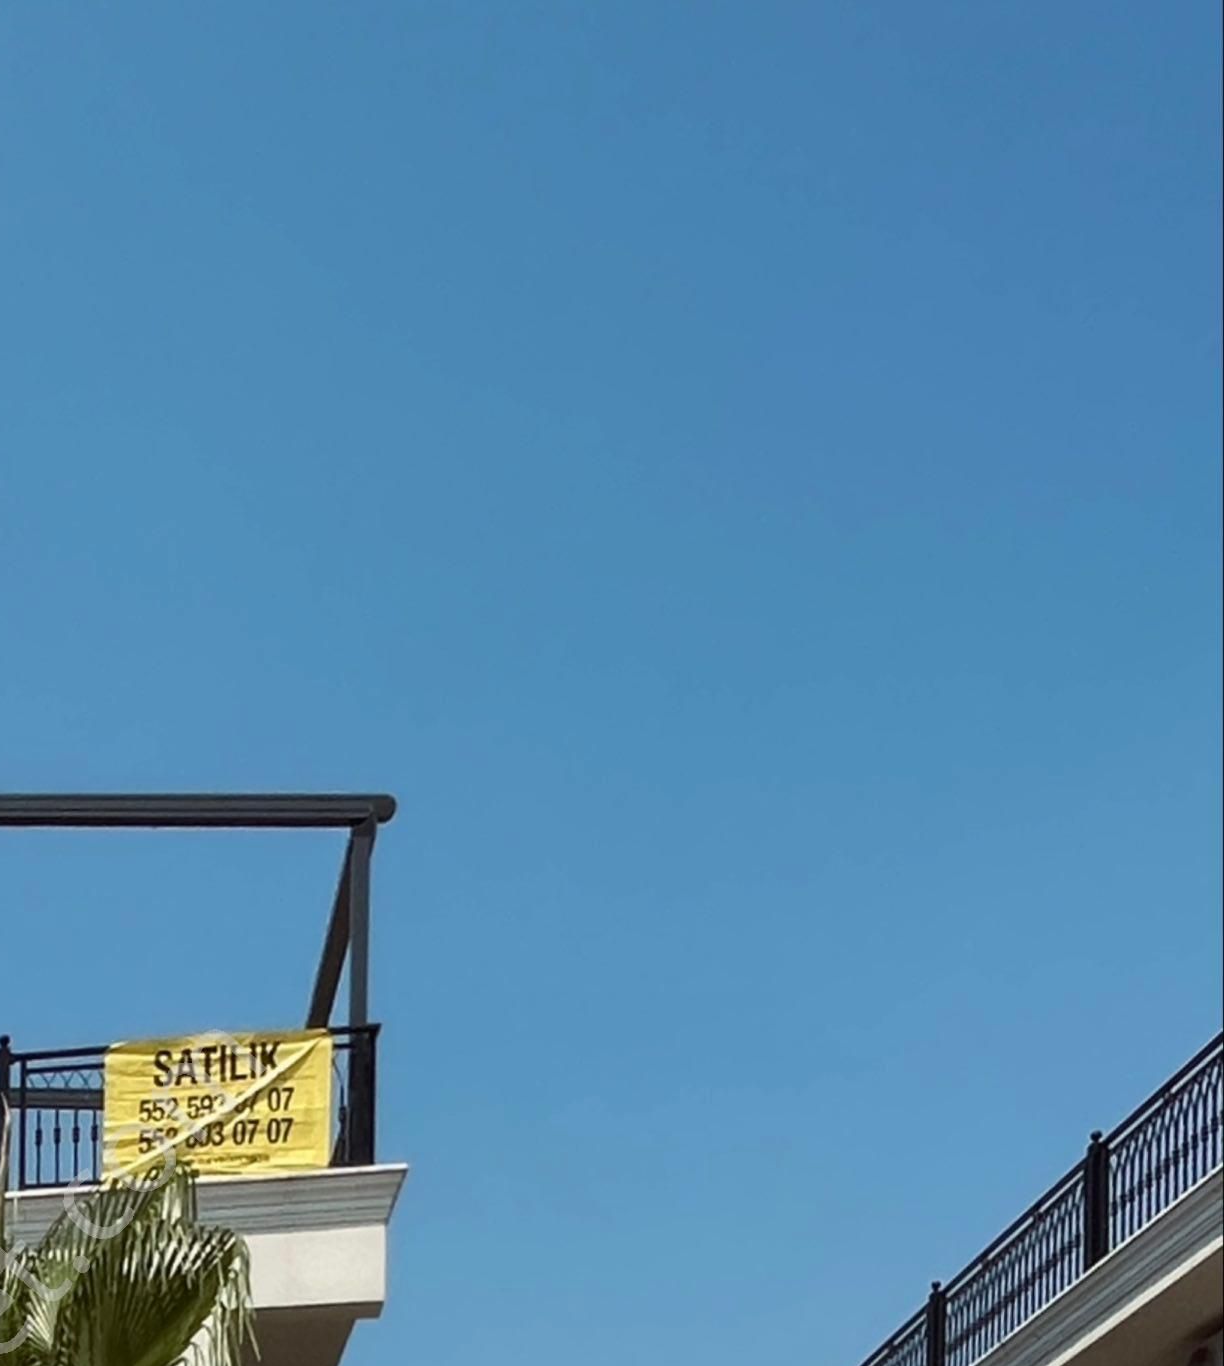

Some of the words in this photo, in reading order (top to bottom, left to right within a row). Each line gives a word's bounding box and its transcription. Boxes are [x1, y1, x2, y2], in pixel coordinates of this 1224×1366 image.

[153, 1041, 280, 1088] SATILIK
[139, 1097, 179, 1123] 552
[268, 1087, 295, 1112] 07
[232, 1119, 259, 1145] 07
[267, 1117, 294, 1144] 07
